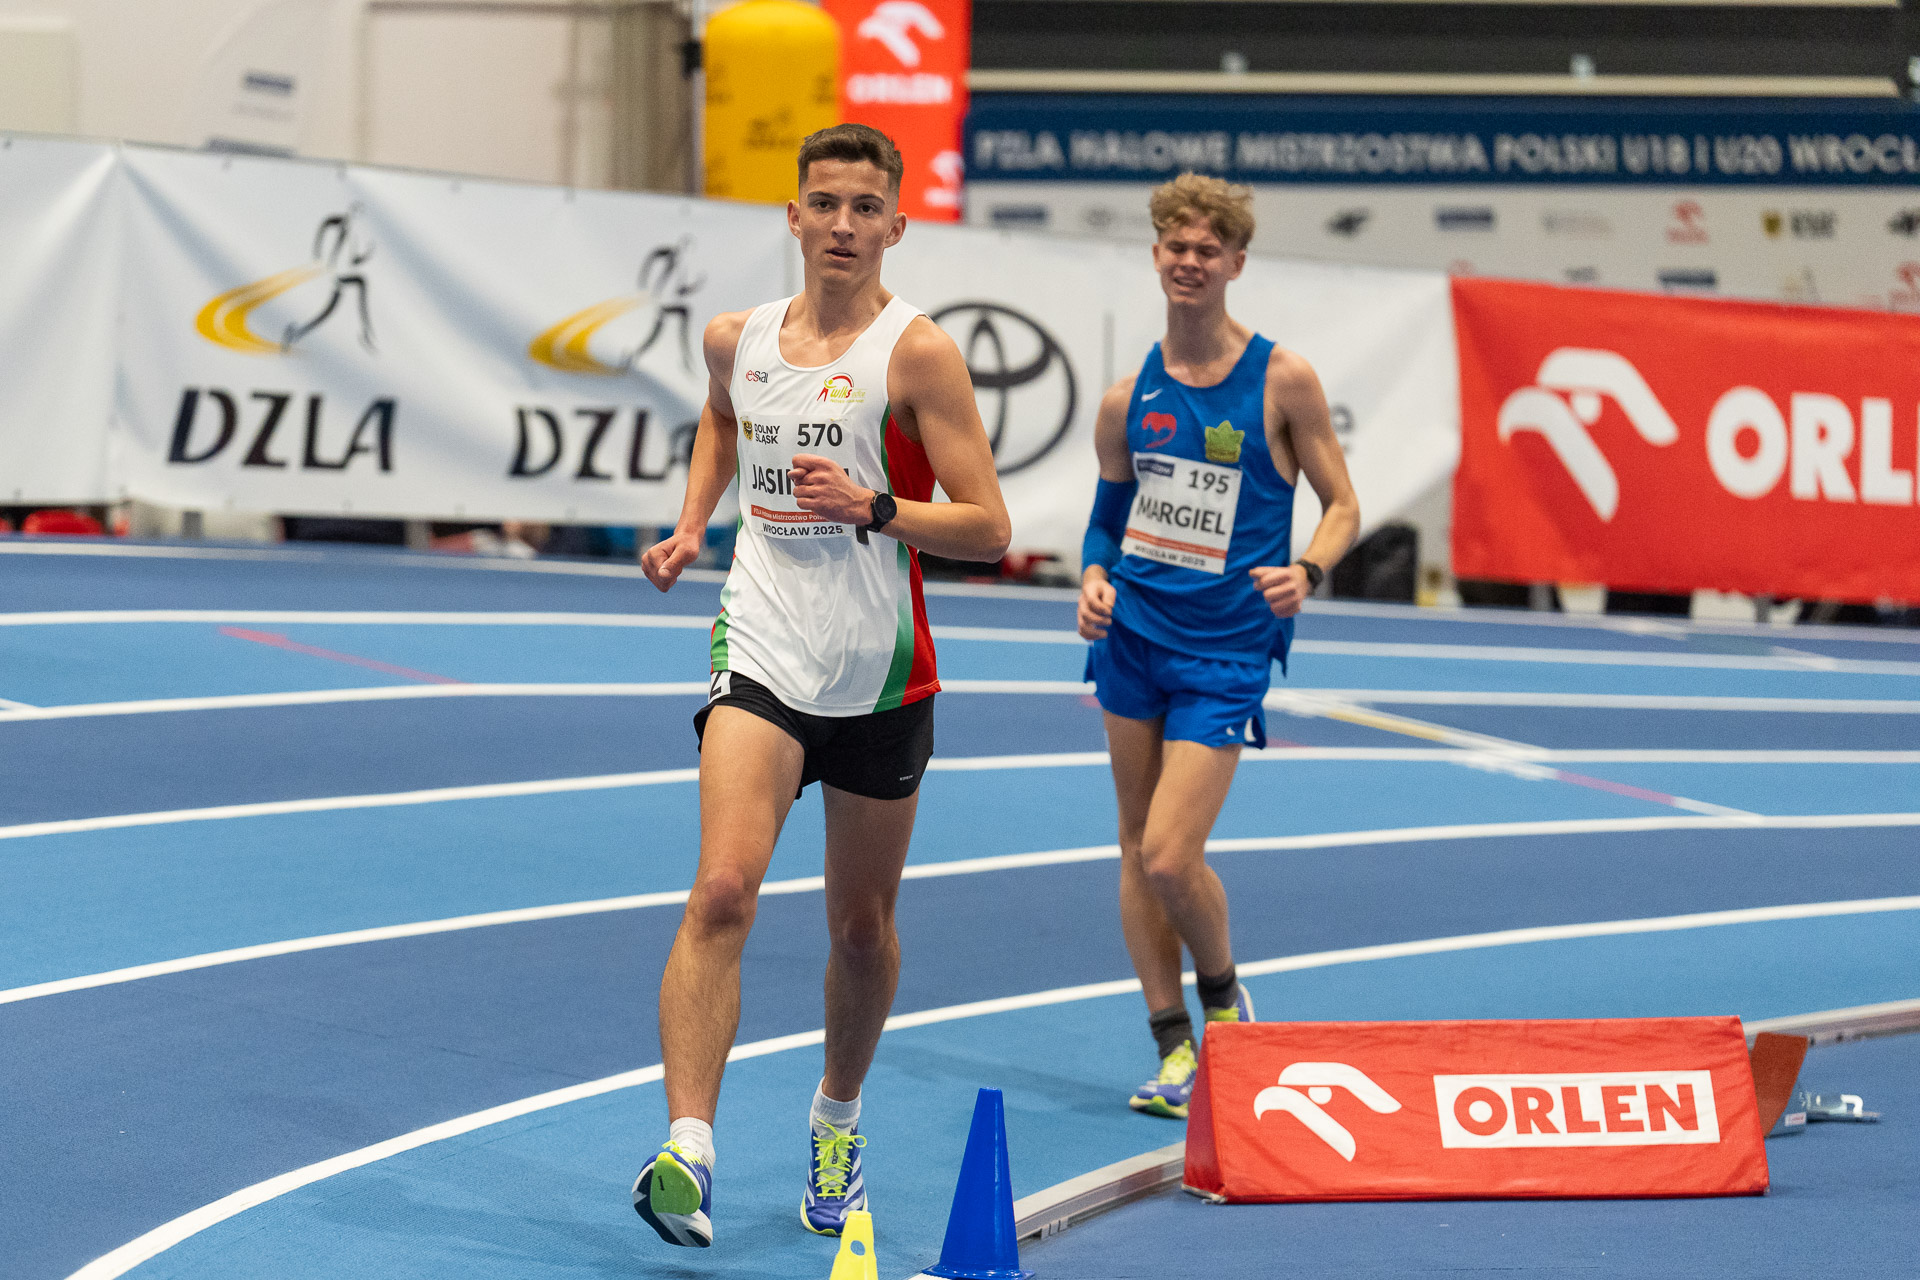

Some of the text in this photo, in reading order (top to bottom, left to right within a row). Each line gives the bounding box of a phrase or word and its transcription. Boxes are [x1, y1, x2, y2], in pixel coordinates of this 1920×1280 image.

[1494, 134, 1616, 173] POLSKI
[1622, 134, 1689, 174] U18
[1716, 134, 1782, 174] U20
[168, 388, 396, 471] DZLA
[754, 423, 780, 435] DOLNY
[797, 423, 843, 447] 570
[1705, 385, 1920, 506] ORL
[1188, 469, 1230, 494] 195
[763, 522, 843, 536] WROCŁAW 2025
[1135, 495, 1226, 535] MARGIEL
[1453, 1084, 1698, 1137] ORLEN
